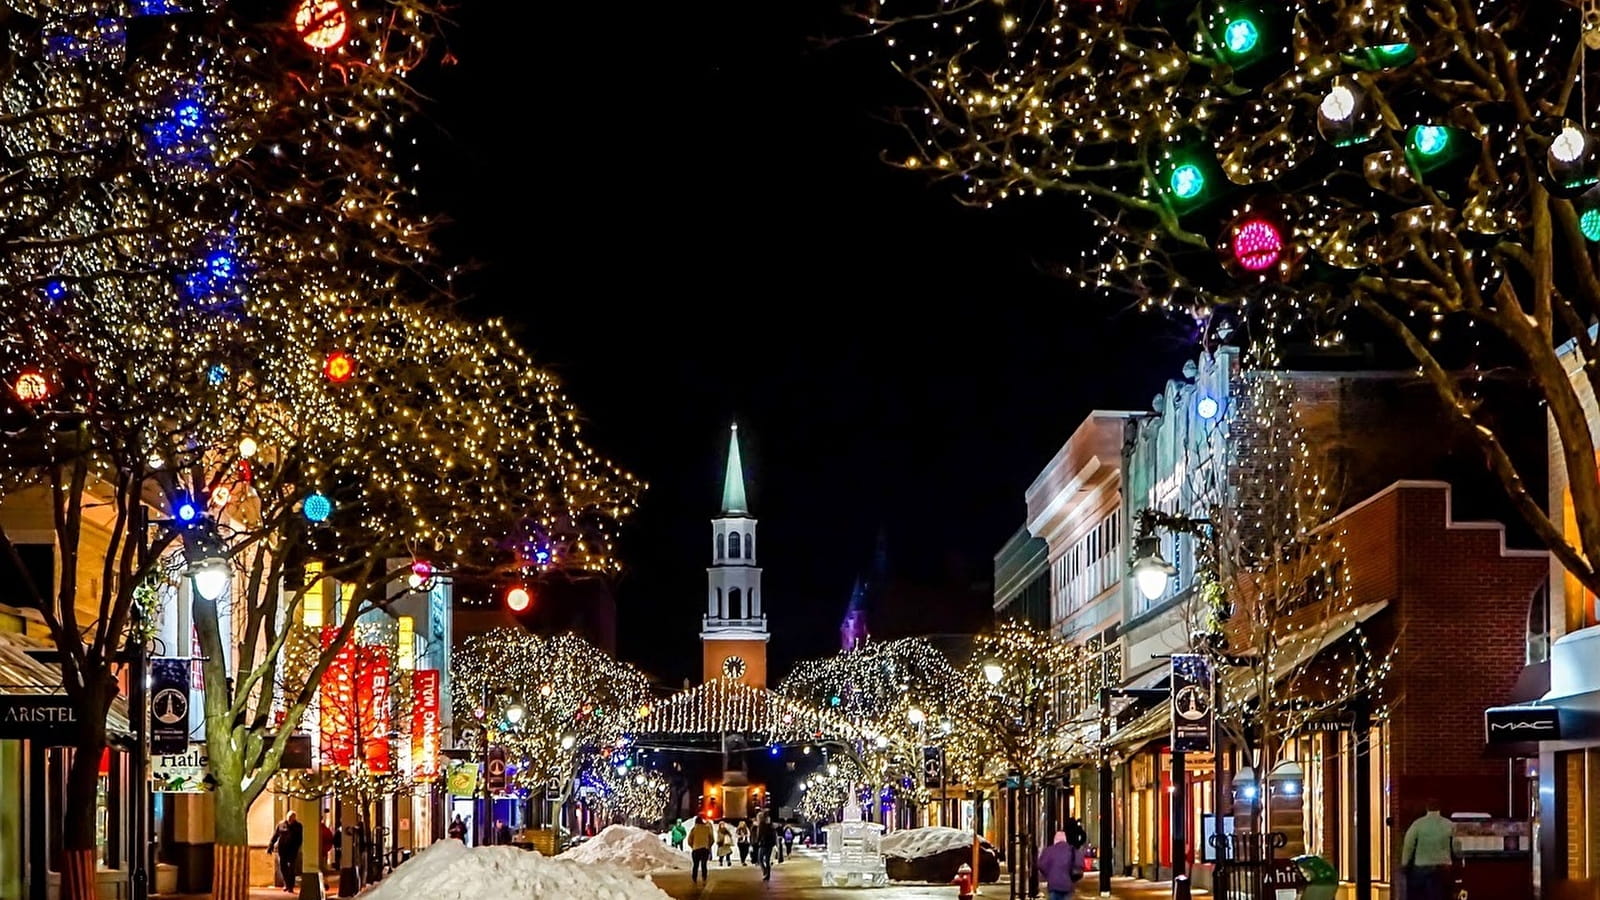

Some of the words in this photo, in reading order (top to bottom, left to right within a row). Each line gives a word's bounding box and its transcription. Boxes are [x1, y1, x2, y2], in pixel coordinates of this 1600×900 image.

[423, 673, 436, 706] MALL
[4, 706, 78, 722] ARISTEL
[1491, 720, 1554, 731] MAC
